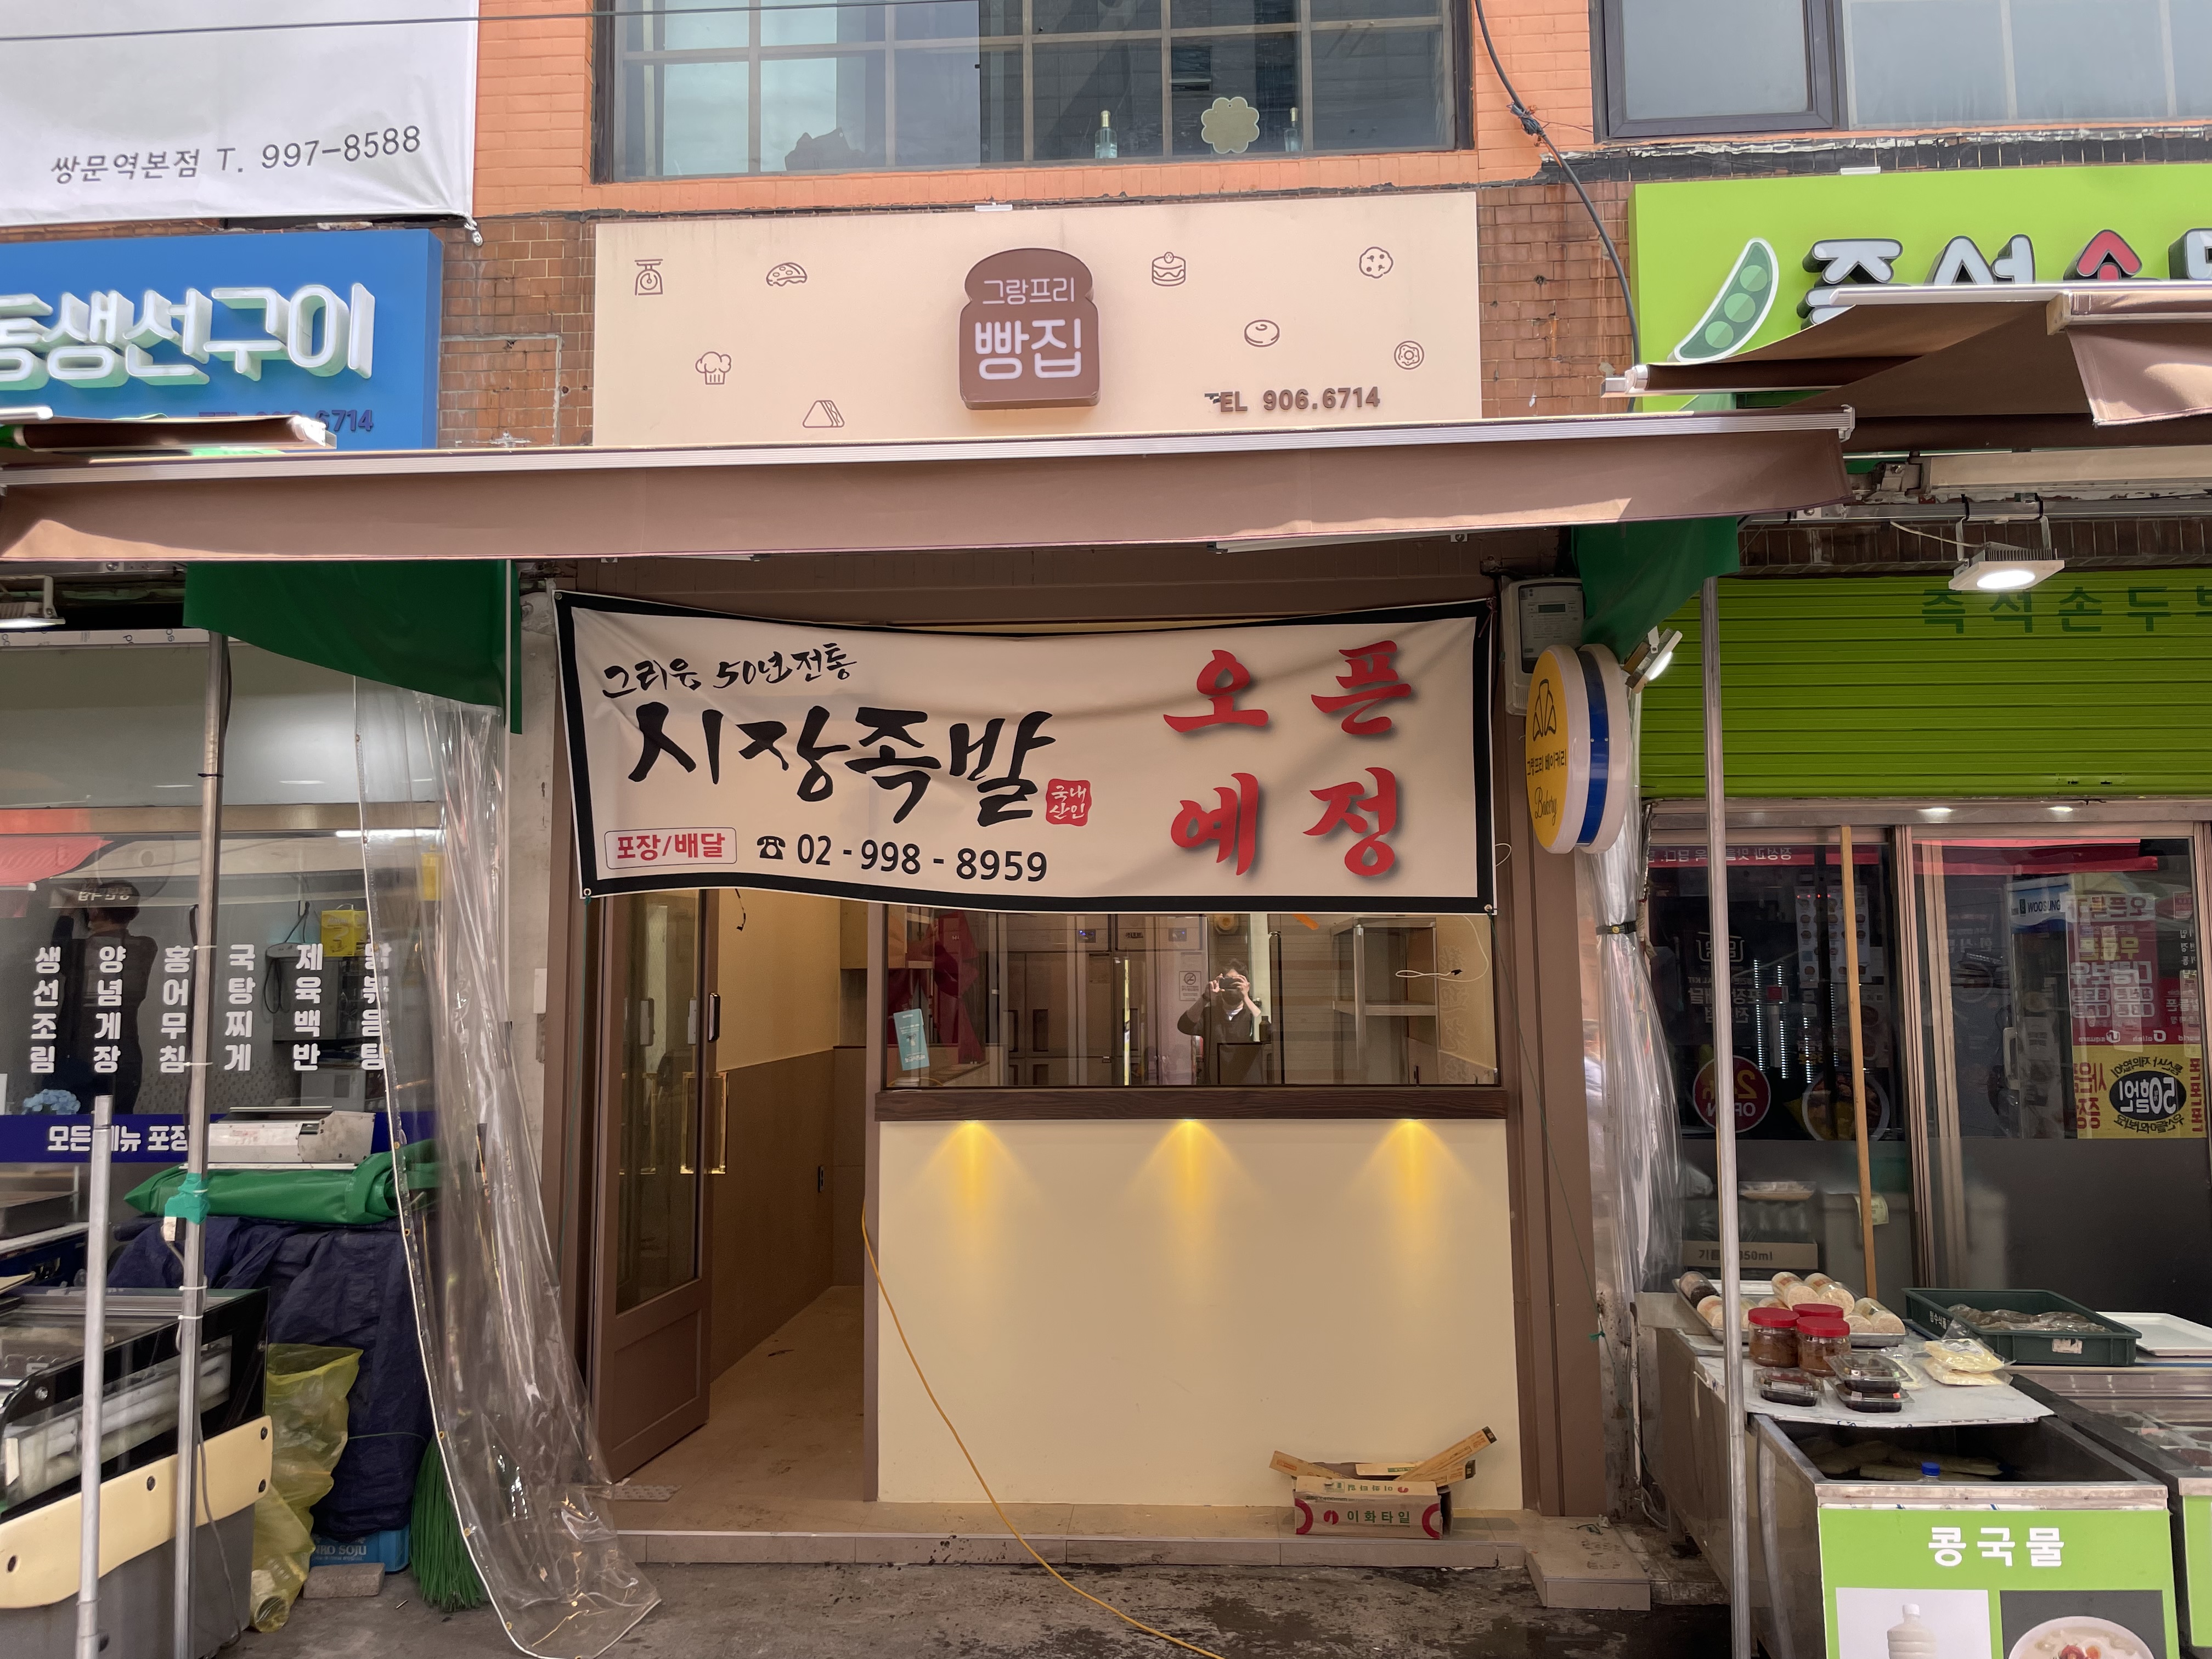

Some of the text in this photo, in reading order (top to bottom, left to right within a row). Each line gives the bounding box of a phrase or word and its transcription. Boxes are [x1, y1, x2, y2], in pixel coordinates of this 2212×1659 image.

[51, 125, 421, 185] 쌍문역본점 T. 997-8588
[983, 277, 1075, 305] 그랑프리
[974, 318, 1082, 380] 빵집
[1263, 386, 1380, 411] 906.6714
[628, 701, 1057, 827] 시장족발
[1527, 748, 1567, 776] 그랑프리 베이커리
[1534, 786, 1558, 826] Bakery
[617, 831, 725, 860] 포장/배달
[2027, 900, 2061, 913] WOOSUNG
[30, 946, 61, 1074] 생선조림
[93, 946, 126, 1074] 양념게장
[160, 946, 191, 1074] 홍어무침
[293, 943, 324, 1071] 제육백반
[48, 1125, 91, 1151] 모든
[1347, 1510, 1410, 1524] 이화타일
[338, 1544, 368, 1556] SOJU
[1928, 1526, 2065, 1568] 콩국물
